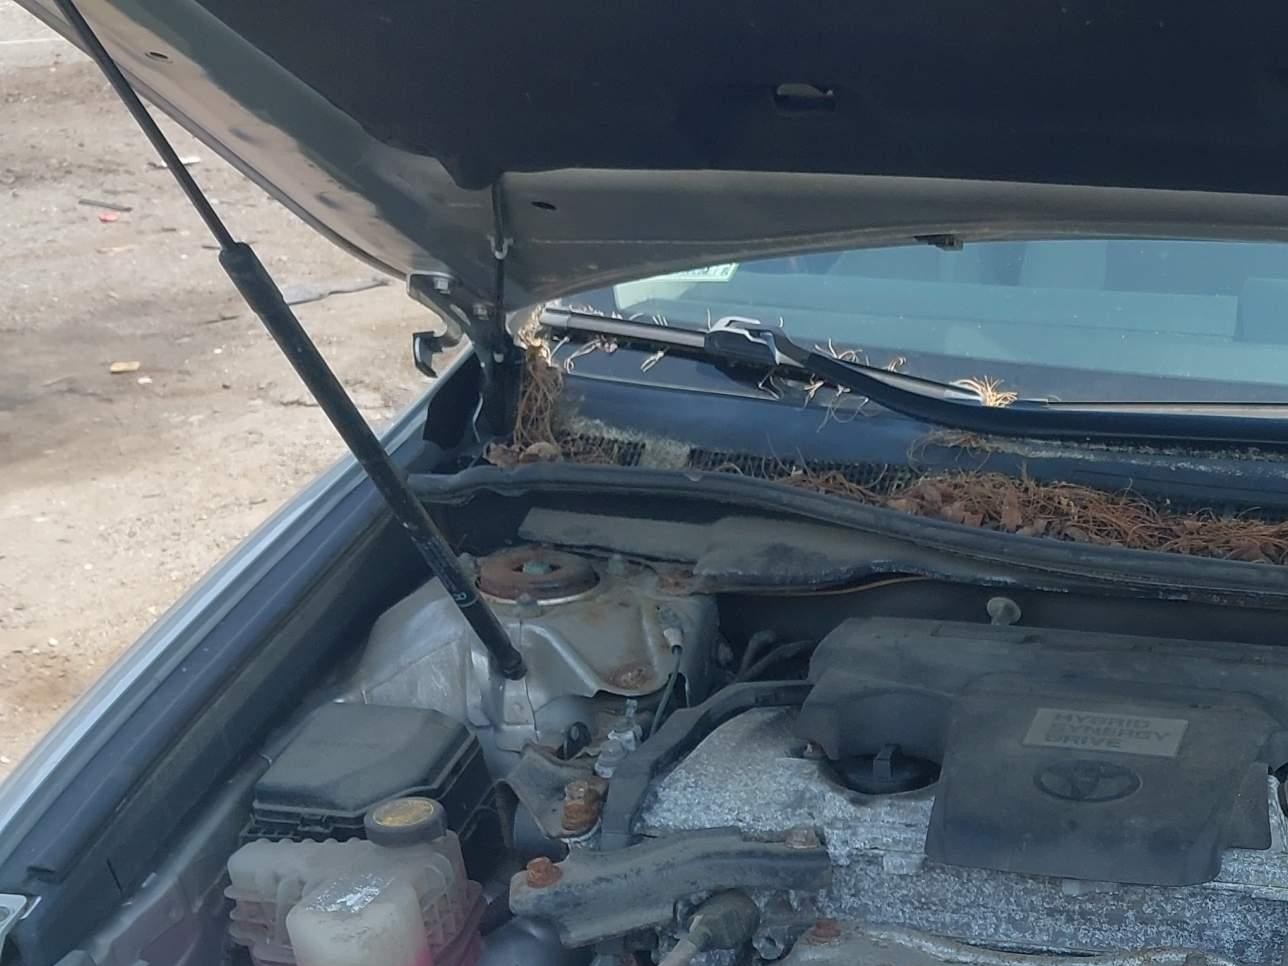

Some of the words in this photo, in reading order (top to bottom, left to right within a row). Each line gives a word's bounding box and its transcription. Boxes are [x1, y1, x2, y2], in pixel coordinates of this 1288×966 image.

[1055, 713, 1150, 729] HYBRID
[1050, 723, 1172, 742] SYNERGY
[1045, 735, 1121, 748] DRIVE
